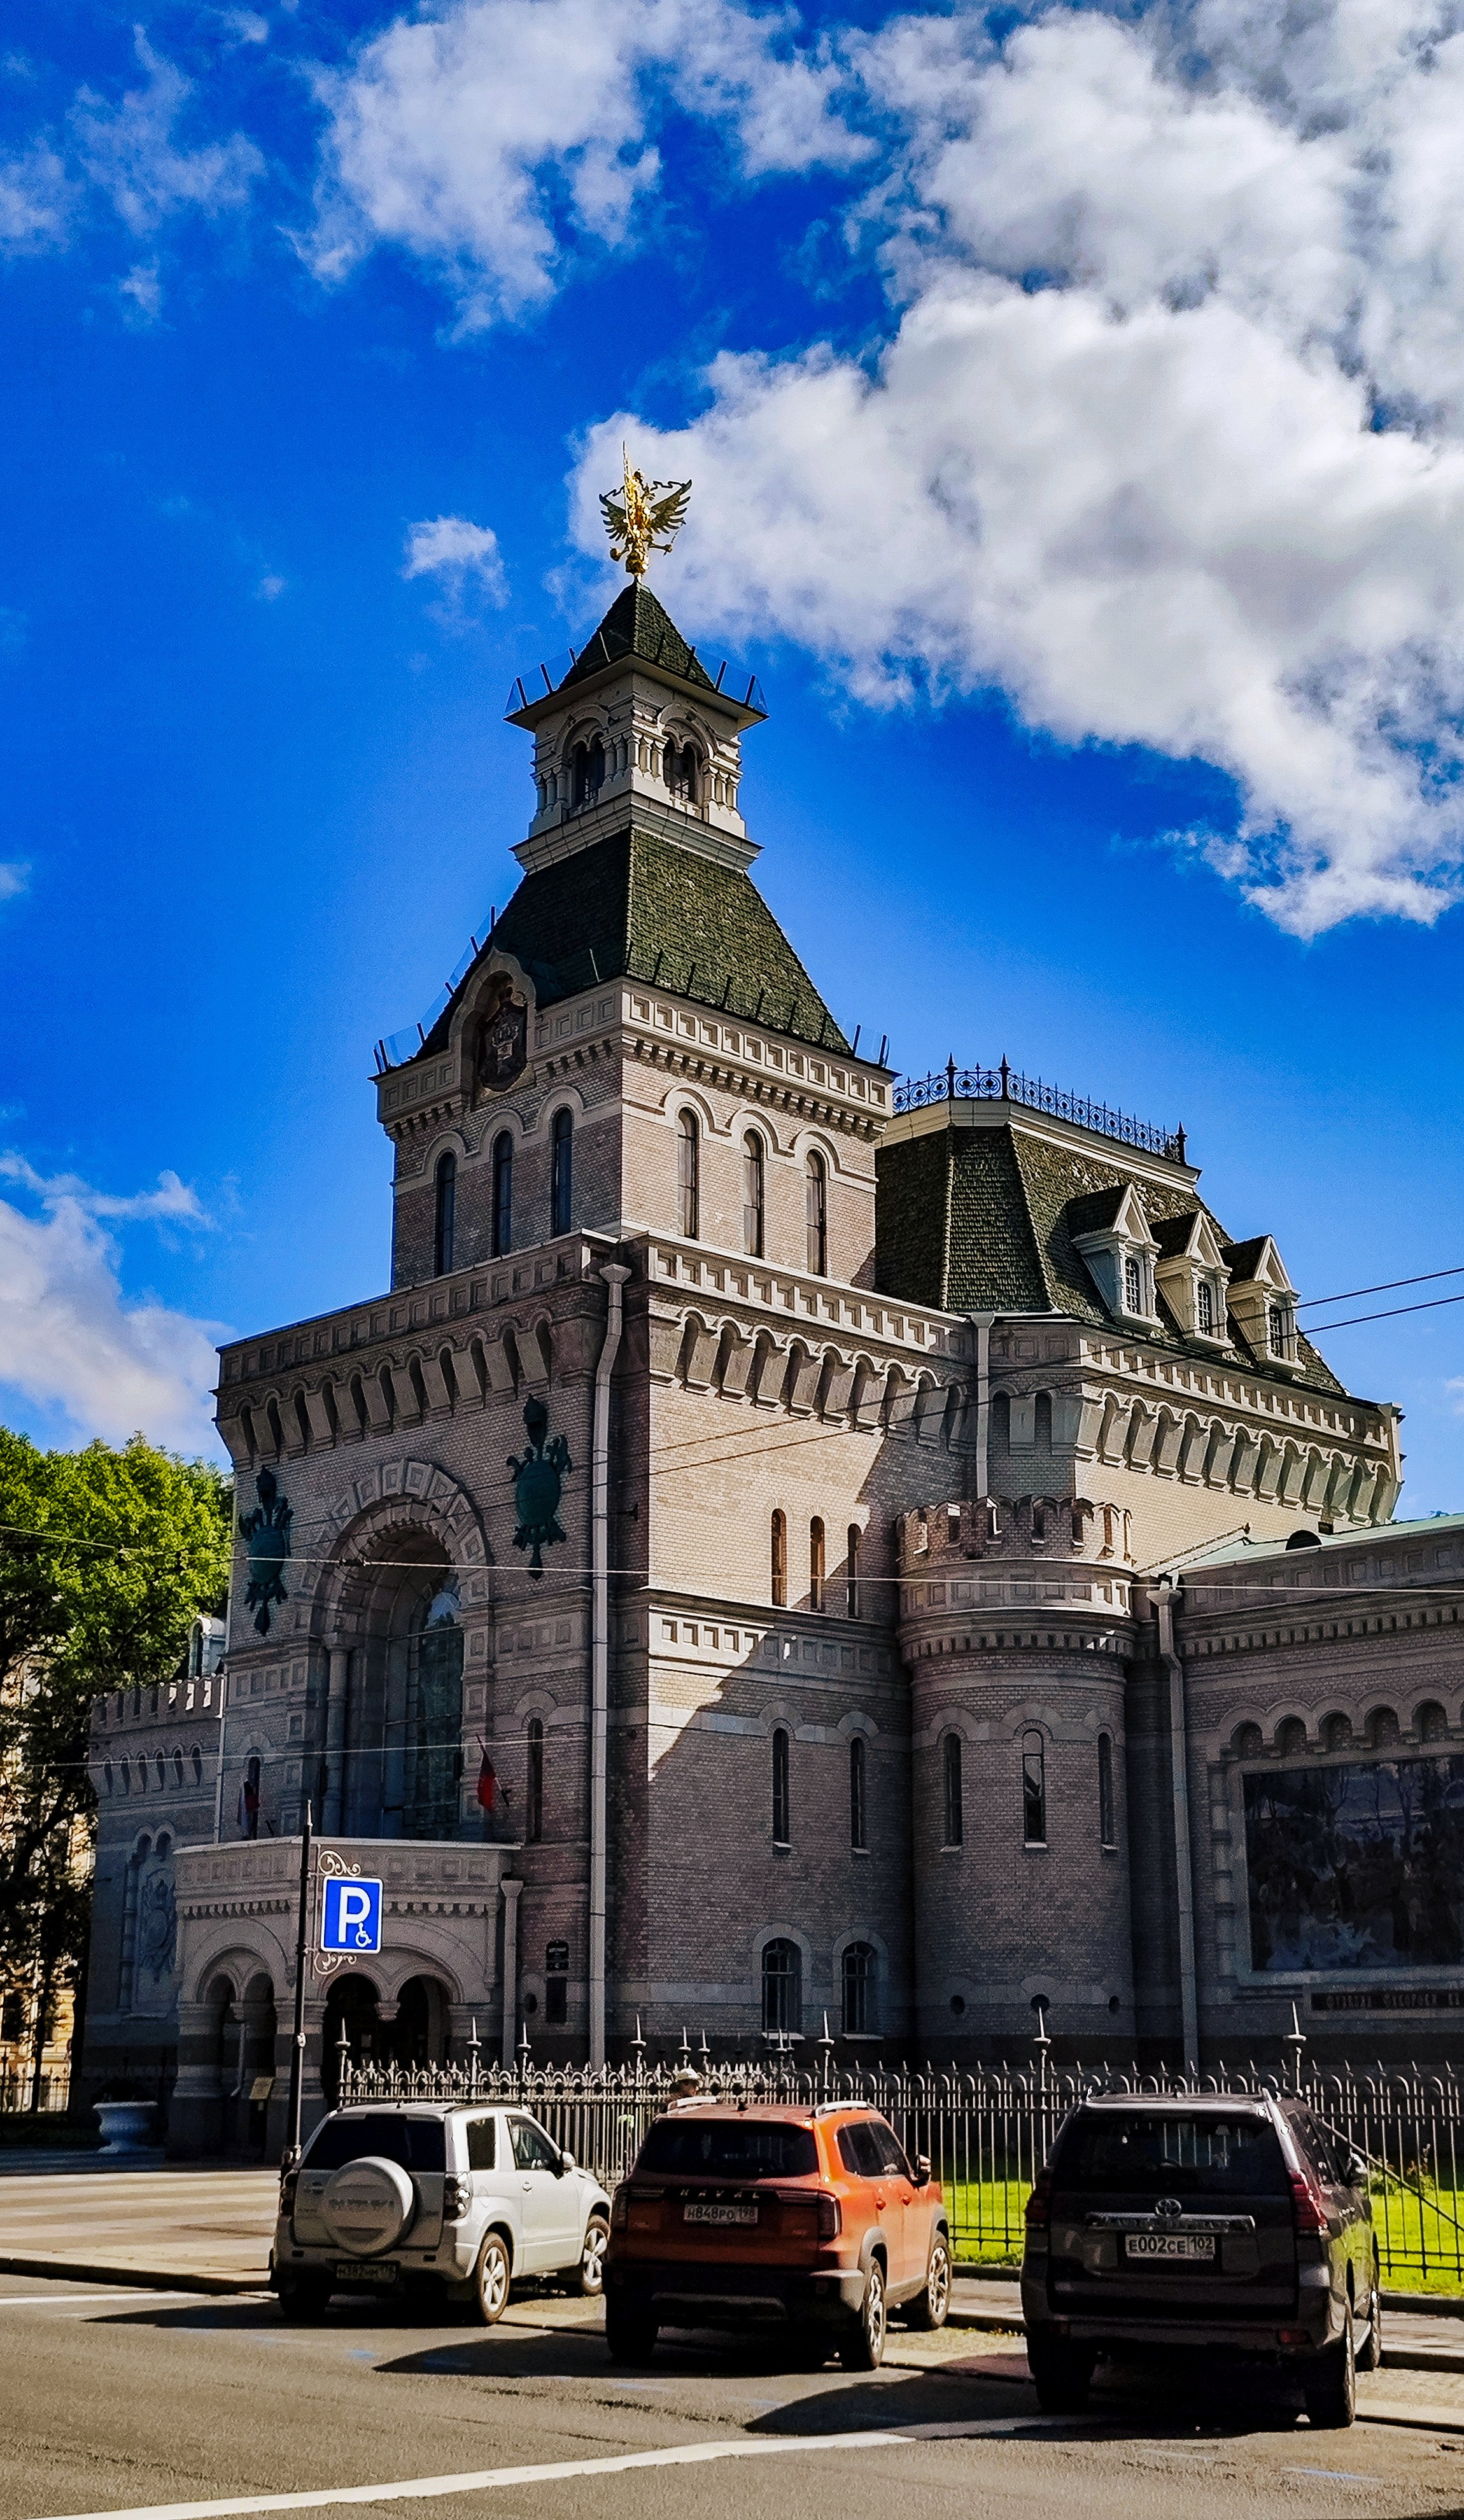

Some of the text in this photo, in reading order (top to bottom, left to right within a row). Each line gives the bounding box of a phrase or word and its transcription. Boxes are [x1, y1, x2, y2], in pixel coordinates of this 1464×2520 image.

[338, 1886, 371, 1943] P
[680, 2188, 760, 2199] HAVAL
[1191, 2236, 1213, 2250] 102
